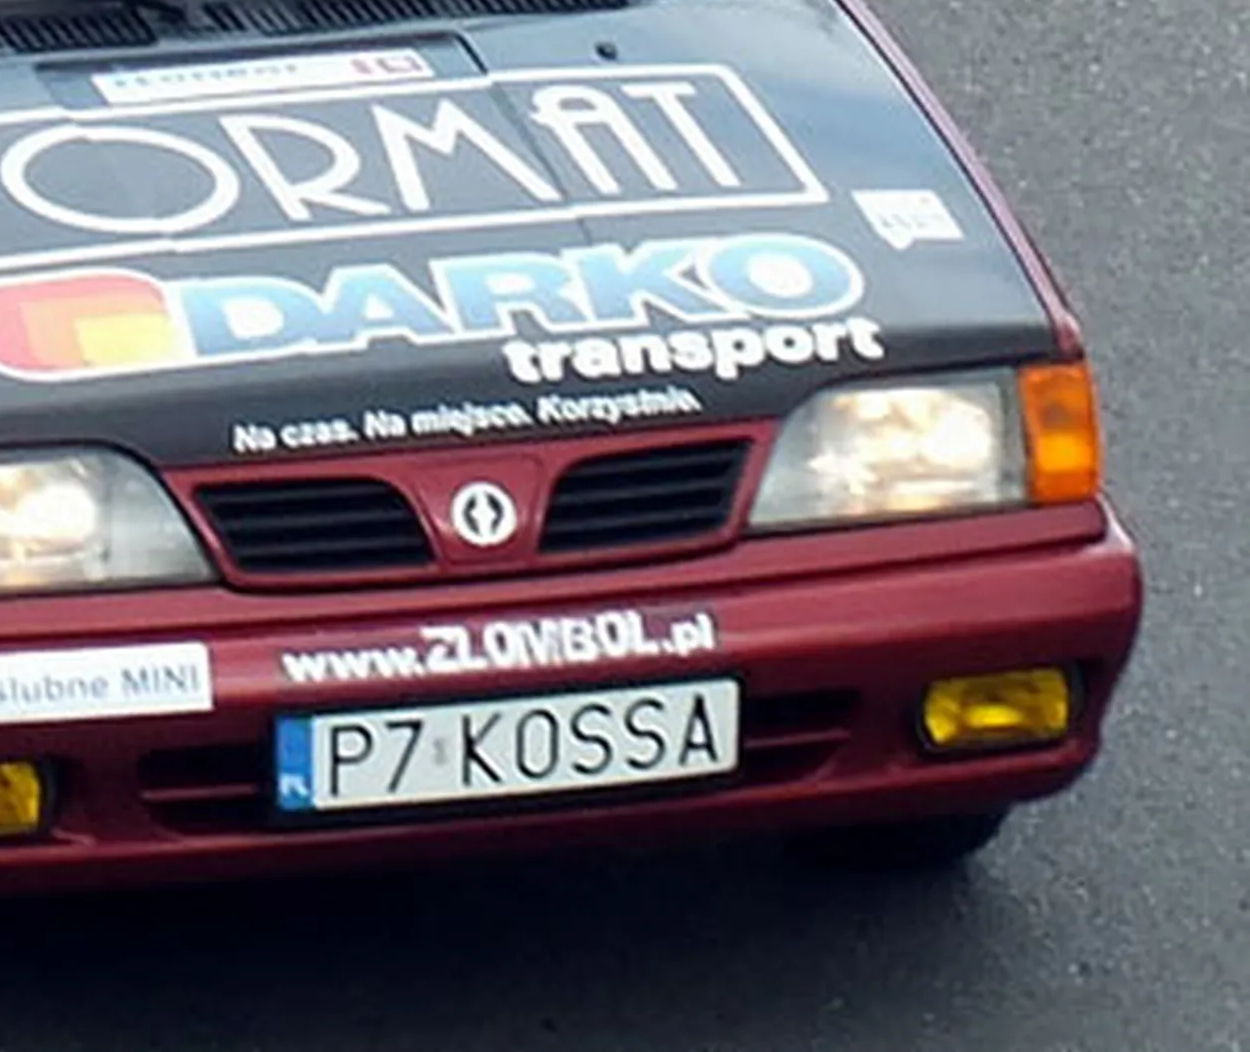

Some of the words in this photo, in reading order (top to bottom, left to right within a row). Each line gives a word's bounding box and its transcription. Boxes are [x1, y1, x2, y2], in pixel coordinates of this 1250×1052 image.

[166, 230, 865, 360] DARKO
[501, 316, 884, 384] transport
[233, 422, 278, 454] Na
[363, 408, 407, 441] Na
[120, 663, 199, 696] MINI
[329, 718, 424, 798] P7
[461, 693, 719, 786] KOSSA
